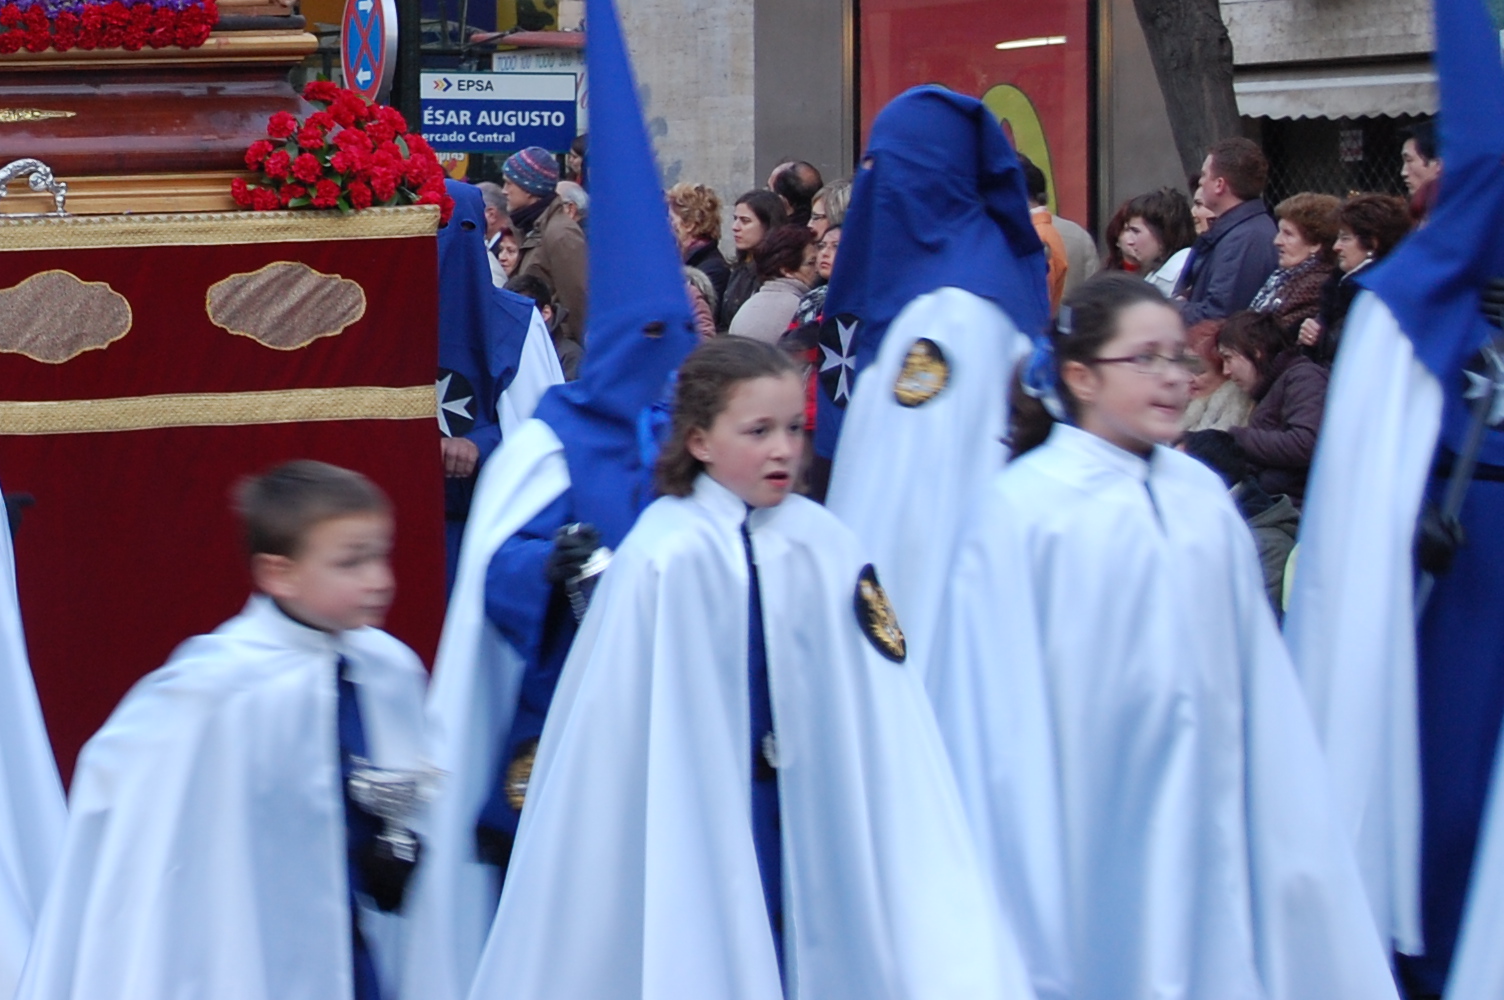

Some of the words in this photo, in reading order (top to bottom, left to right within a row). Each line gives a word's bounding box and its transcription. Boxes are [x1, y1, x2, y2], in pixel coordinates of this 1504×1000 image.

[457, 79, 494, 91] EPSA
[423, 106, 471, 126] ÉSAR
[476, 110, 565, 127] AUGUSTO
[421, 131, 465, 143] ercado
[468, 131, 516, 143] Central
